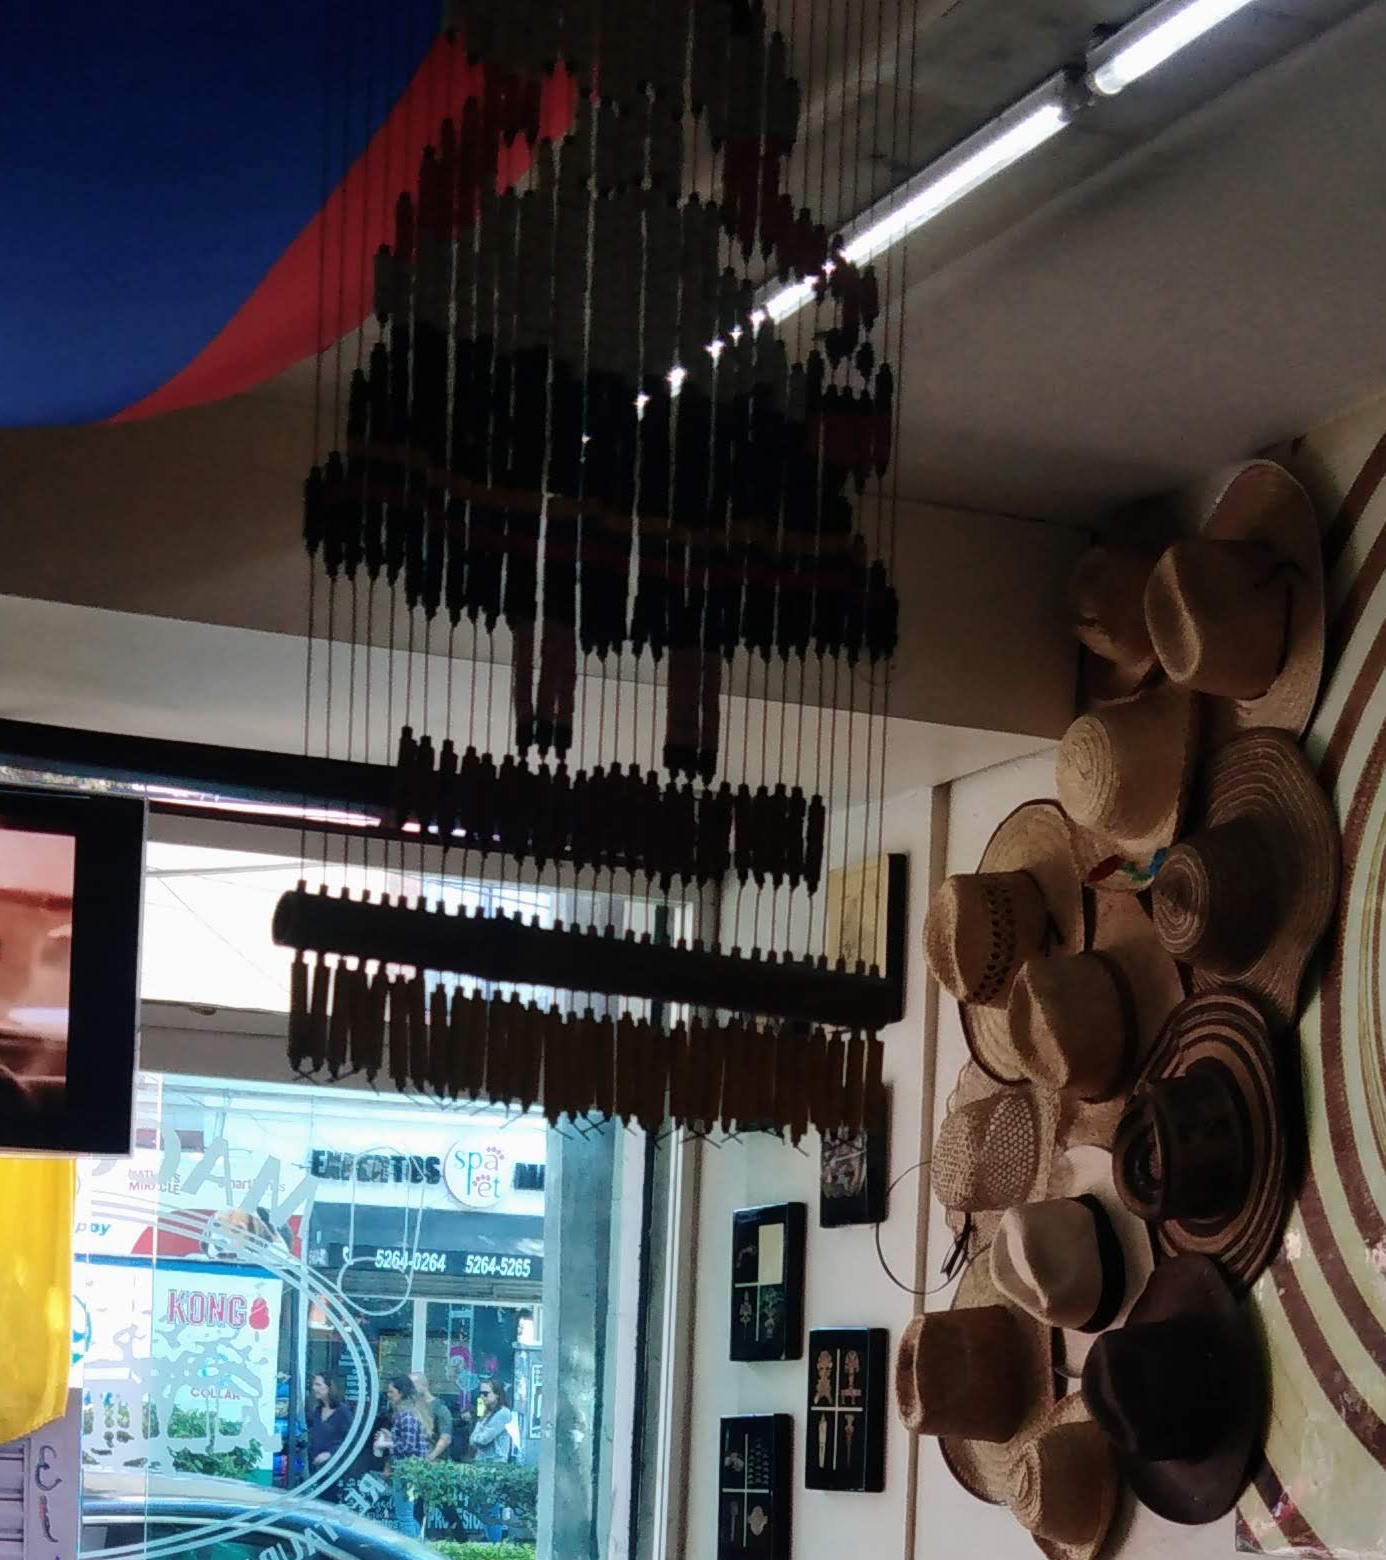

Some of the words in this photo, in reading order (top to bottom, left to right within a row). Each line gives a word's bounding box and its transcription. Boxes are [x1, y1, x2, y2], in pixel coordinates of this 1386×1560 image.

[375, 1249, 446, 1273] 5264-0264
[465, 1254, 531, 1278] 5264-5265
[166, 1288, 247, 1329] KONG
[190, 1386, 241, 1401] COLLAR
